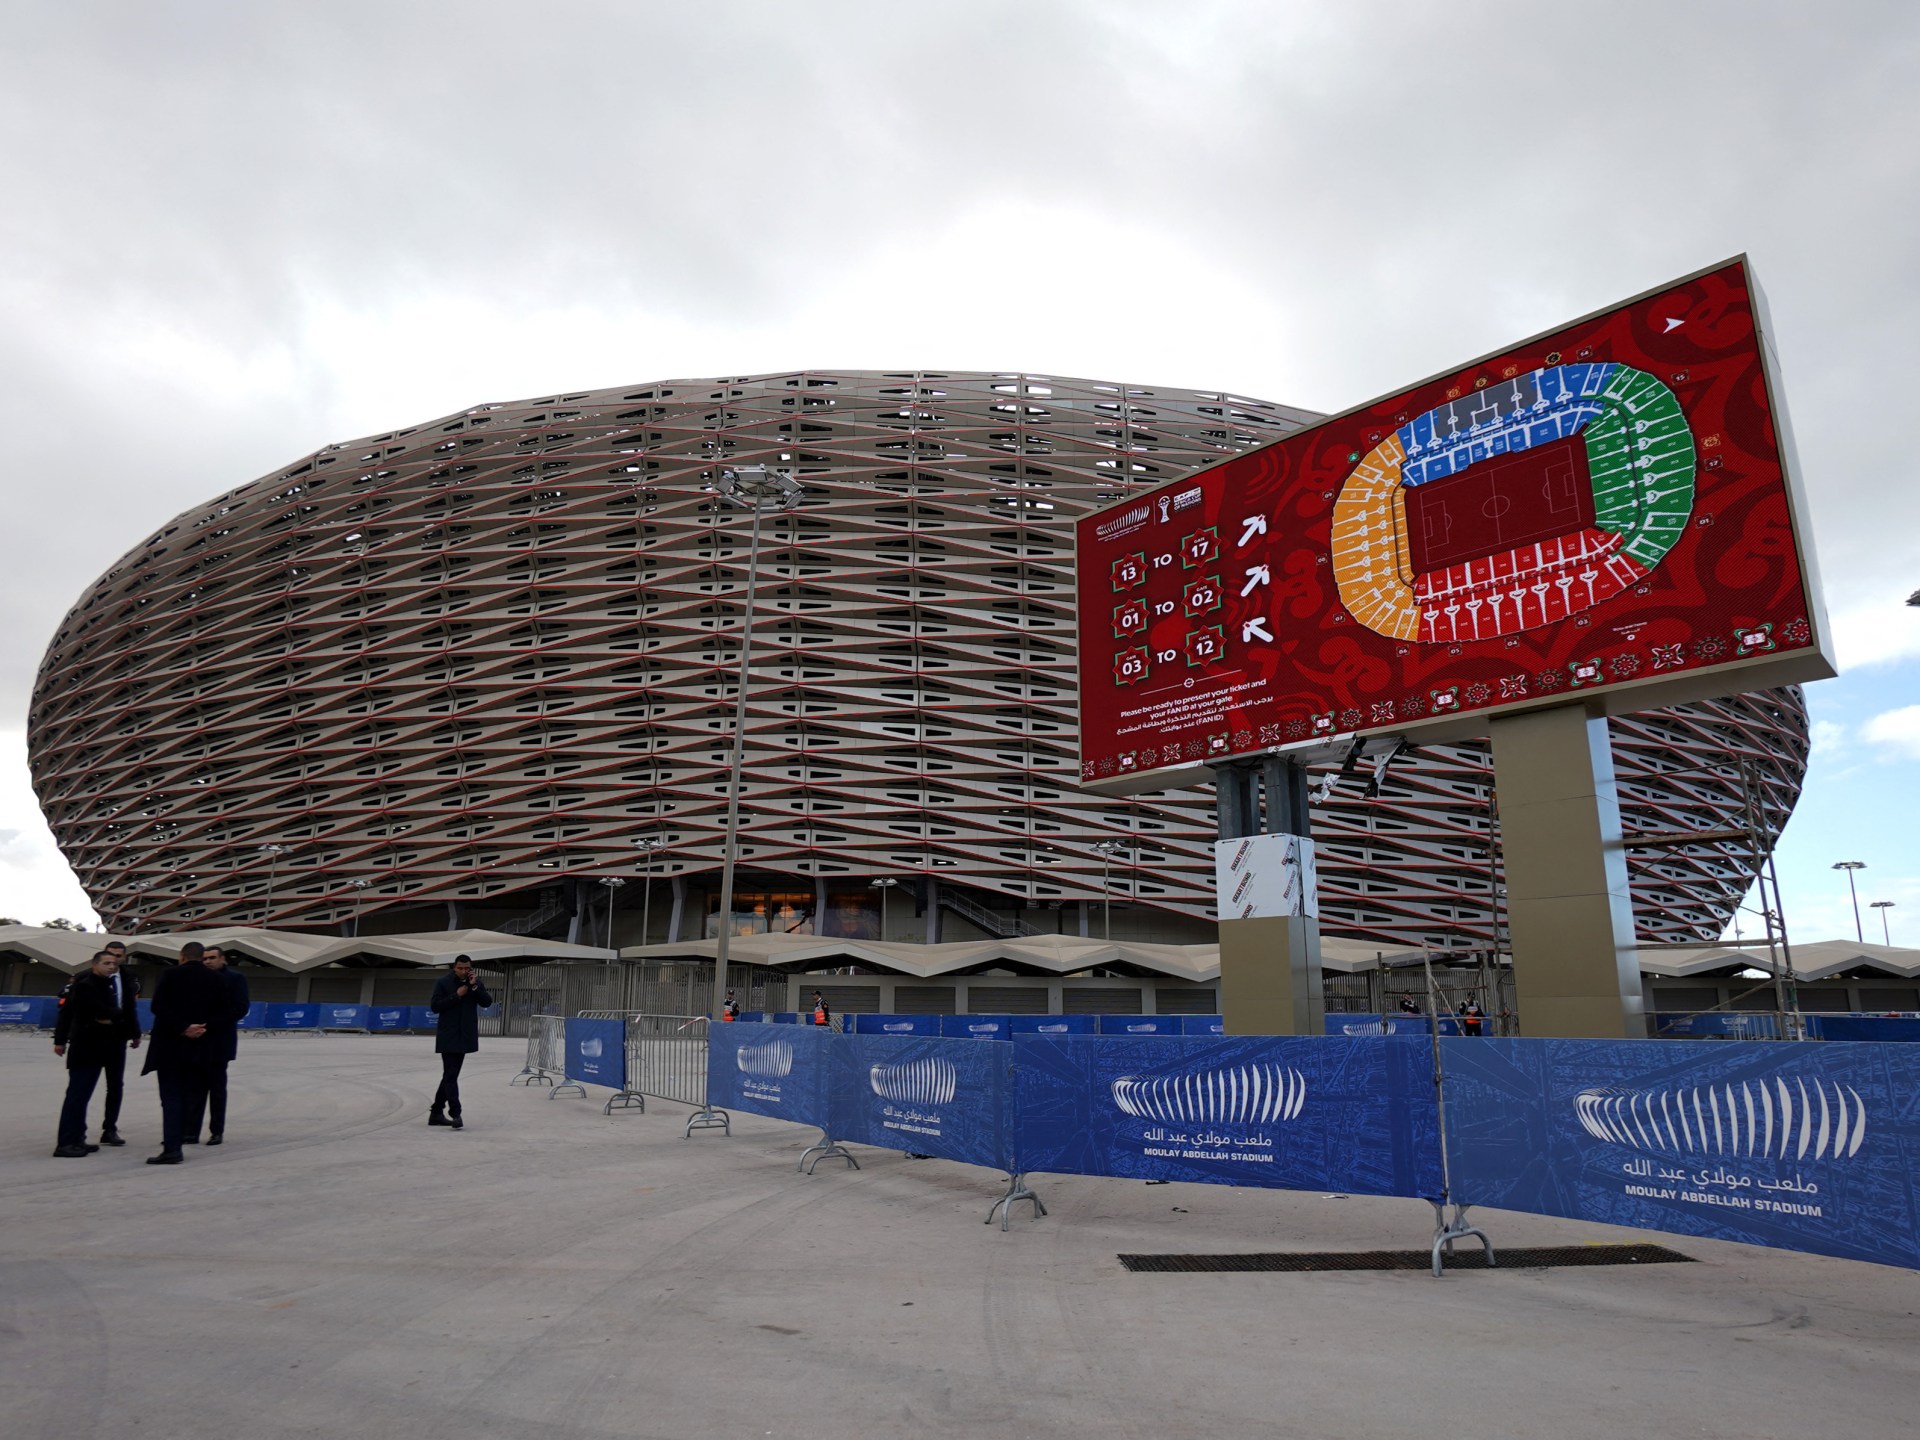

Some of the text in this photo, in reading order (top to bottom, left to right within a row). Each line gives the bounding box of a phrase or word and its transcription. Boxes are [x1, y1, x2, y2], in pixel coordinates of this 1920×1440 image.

[1121, 541, 1209, 581] 13 TO 17
[1122, 590, 1214, 627] 01 TO 02
[1122, 640, 1214, 675] 03 TO 12
[1120, 708, 1143, 717] Please
[1153, 701, 1173, 710] ready
[1182, 692, 1210, 705] present
[1211, 688, 1229, 698] your
[1230, 682, 1250, 692] ticket
[1251, 678, 1267, 688] and
[1150, 711, 1166, 720] your
[1167, 707, 1181, 715] FAN
[1197, 700, 1215, 709] your
[1216, 696, 1233, 706] gate
[1143, 1128, 1272, 1148] ملعب مولاي عبد الله
[1144, 1148, 1273, 1162] MOULAY ABDELLAH STADIUM
[1623, 1158, 1818, 1194] ملعب مولاي عبد الله
[1625, 1184, 1822, 1217] MOULAY ABDELLAH STADIUM
